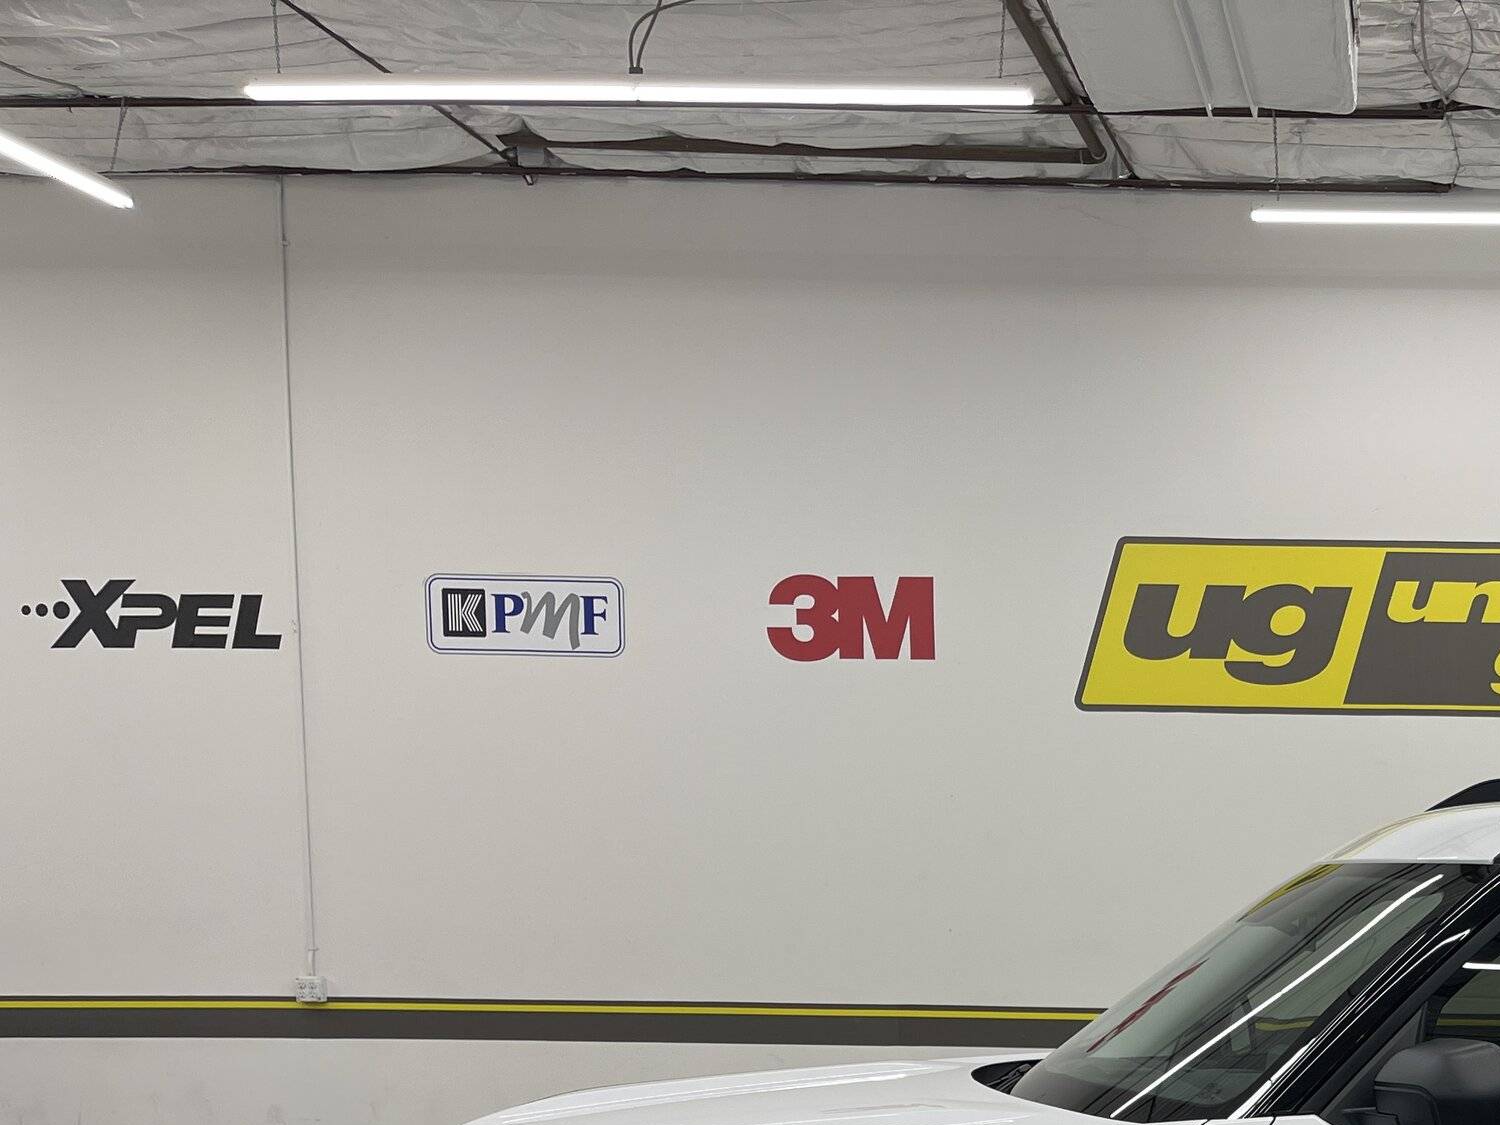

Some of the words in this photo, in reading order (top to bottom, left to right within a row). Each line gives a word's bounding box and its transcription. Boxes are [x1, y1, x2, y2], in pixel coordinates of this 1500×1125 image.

[50, 579, 282, 650] XPEL
[766, 574, 936, 663] 3M
[1123, 583, 1352, 686] ug
